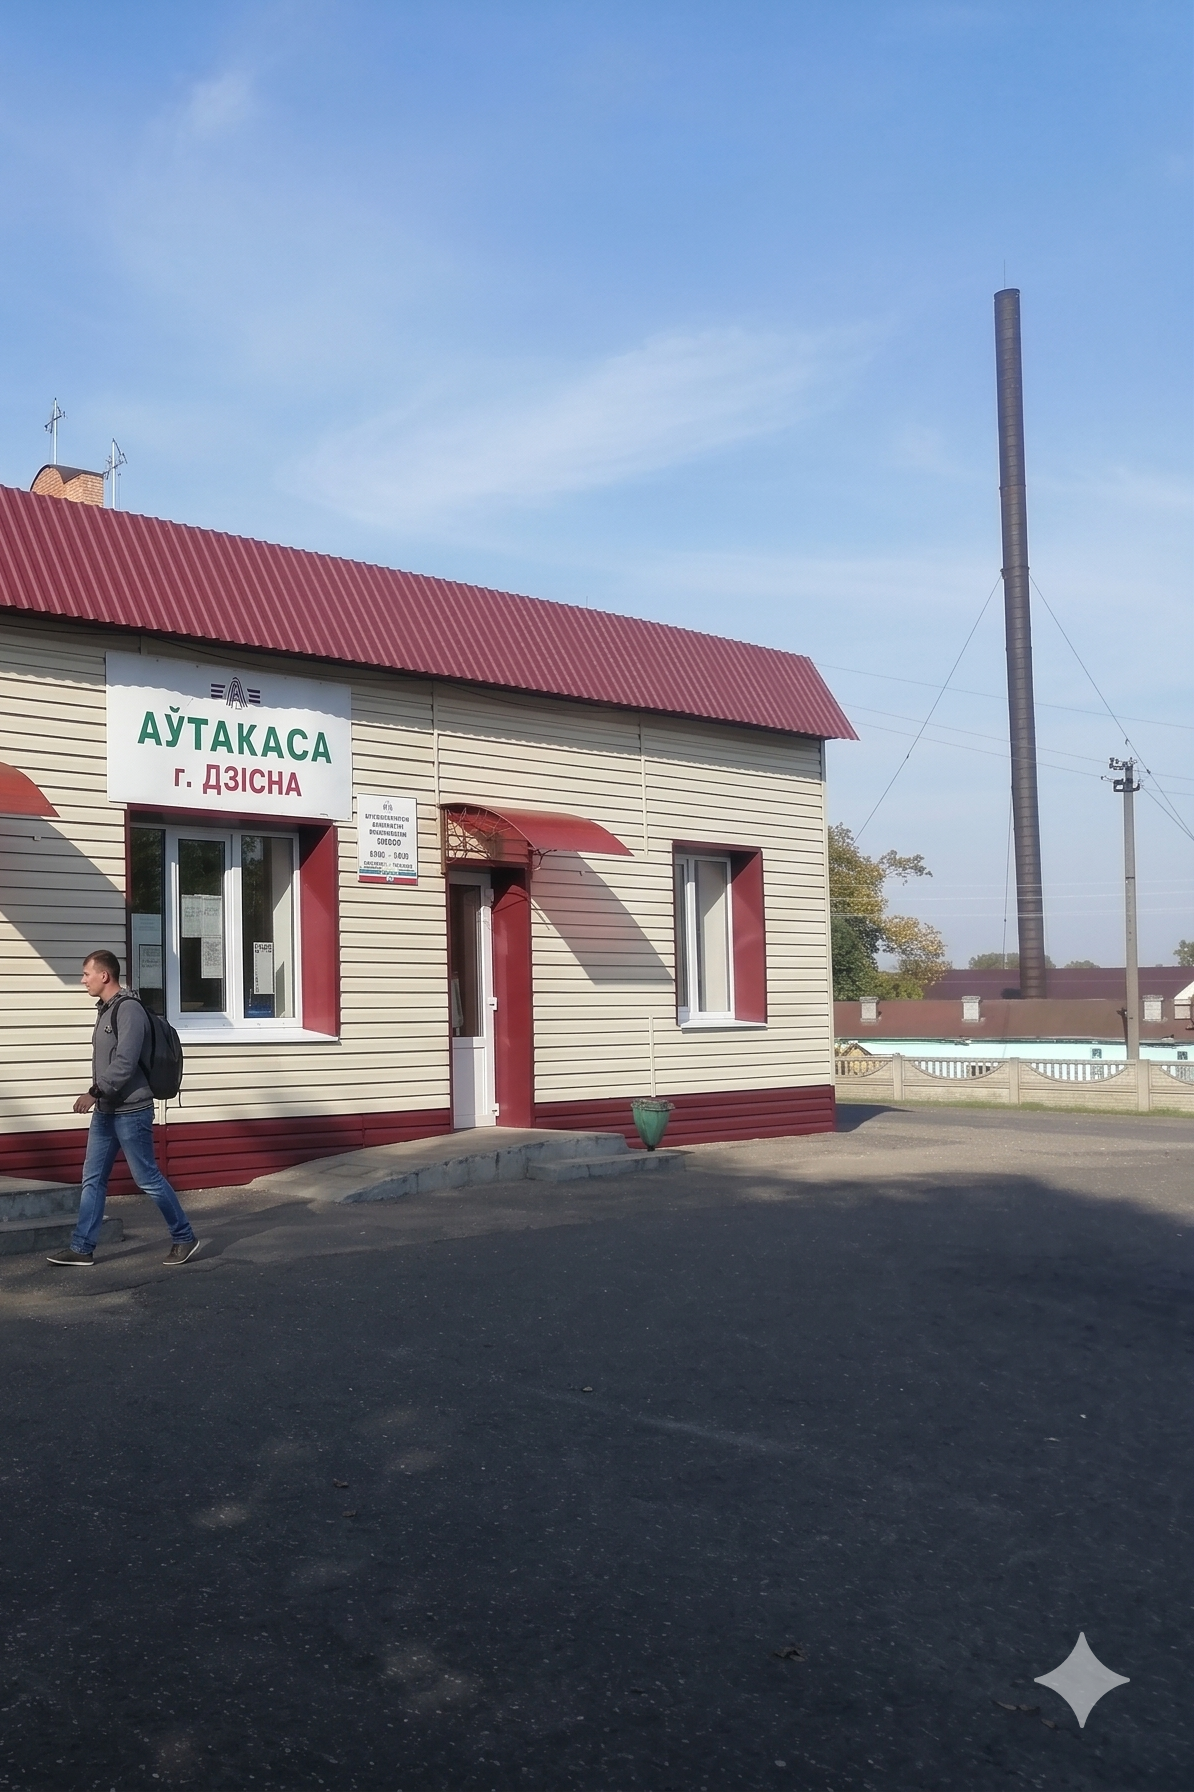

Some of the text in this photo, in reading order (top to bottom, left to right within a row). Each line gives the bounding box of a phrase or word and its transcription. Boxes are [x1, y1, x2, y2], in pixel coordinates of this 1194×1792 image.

[137, 705, 332, 764] АЎТАКАСА
[174, 763, 302, 797] г. ДЗІСНА
